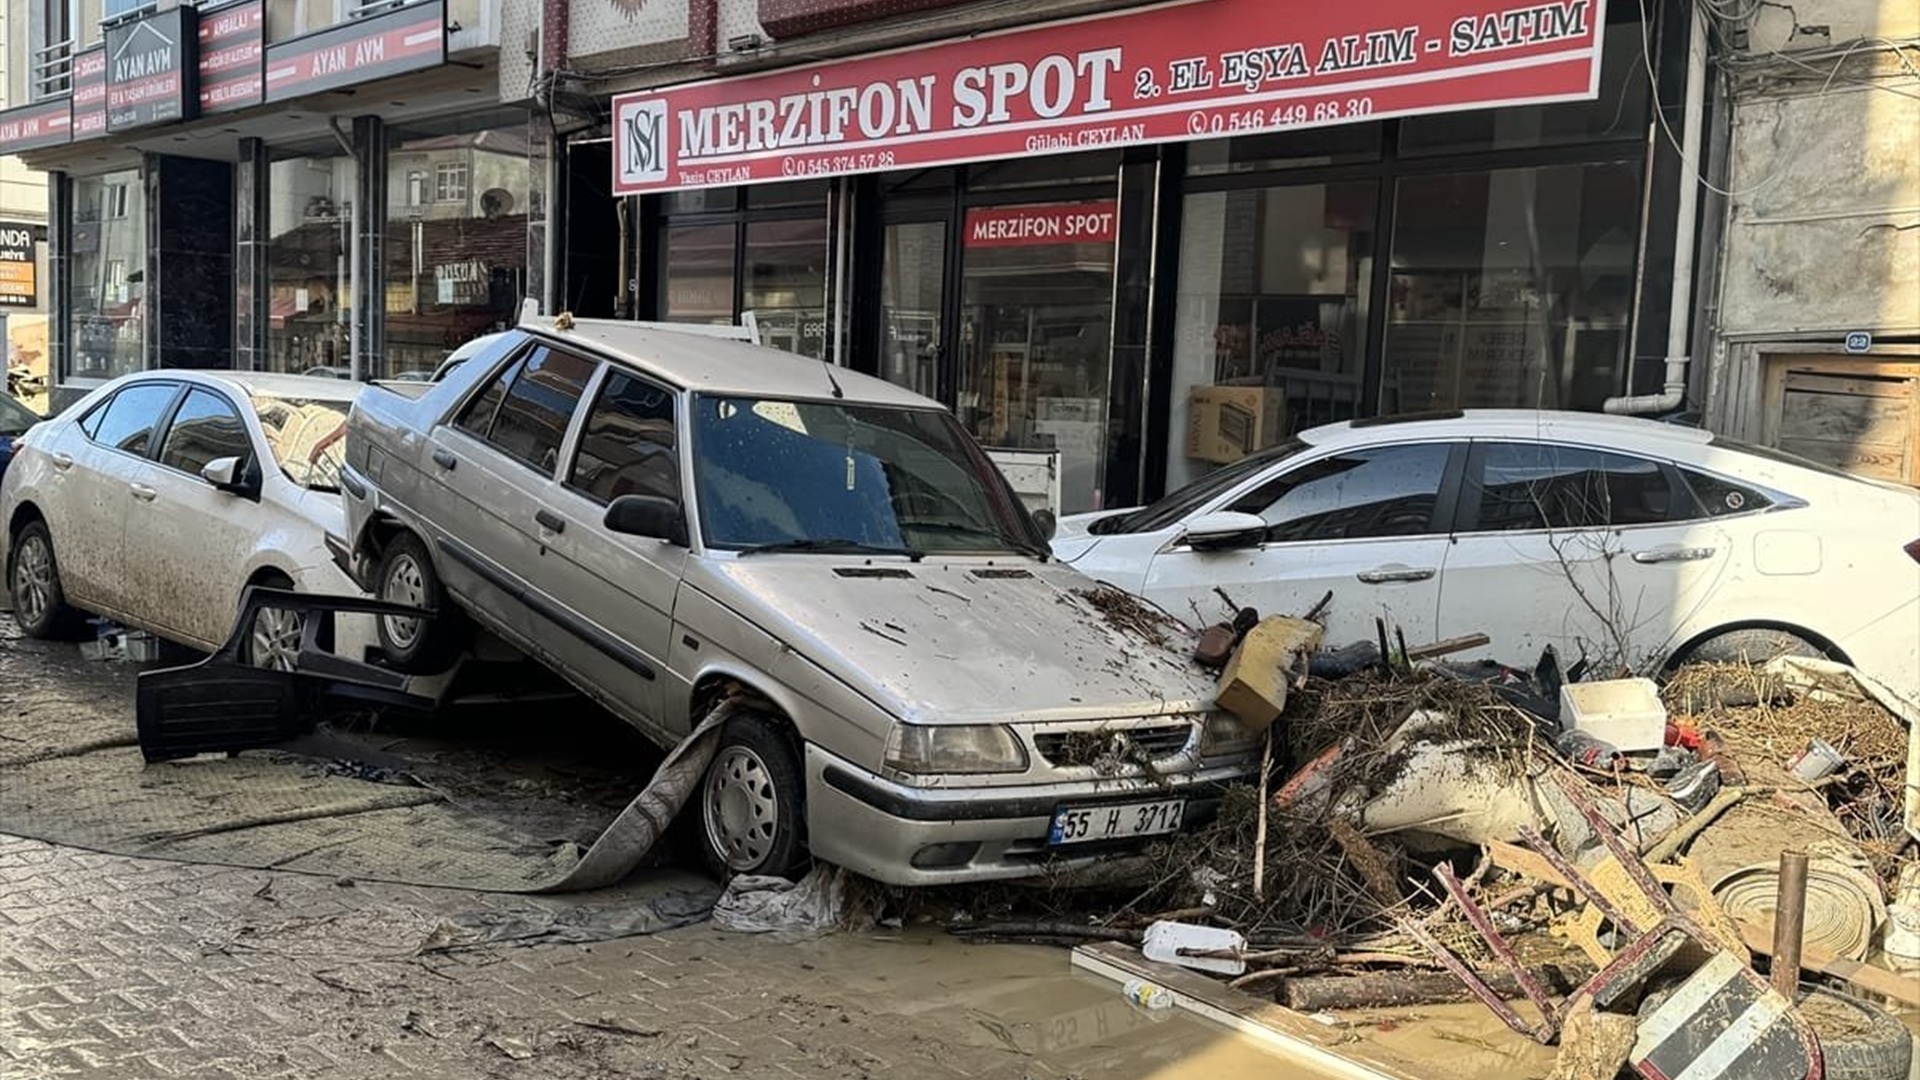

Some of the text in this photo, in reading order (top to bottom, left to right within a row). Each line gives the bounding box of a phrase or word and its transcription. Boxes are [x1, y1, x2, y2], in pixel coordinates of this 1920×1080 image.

[115, 47, 171, 82] AYAN AVM
[312, 37, 384, 76] AYAN AVM
[1135, 69, 1160, 98] 2.
[1170, 58, 1211, 92] EL
[1220, 44, 1309, 91] EŞYA
[1316, 28, 1417, 74] ALIM
[1450, 1, 1588, 55] SATIM
[677, 47, 1122, 158] MERZİFON SPOT
[1211, 97, 1372, 132] 0 546 449 68 30
[22, 118, 39, 137] AVM
[1026, 124, 1145, 151] Gülabi CEYLAN
[706, 165, 750, 184] CEYLAN
[797, 151, 895, 176] 0 545 374 57 28
[973, 213, 1112, 240] MERZİFON SPOT
[1850, 336, 1867, 347] 22
[1064, 812, 1091, 839] 55
[1105, 809, 1120, 834] H
[1134, 803, 1181, 832] 3712
